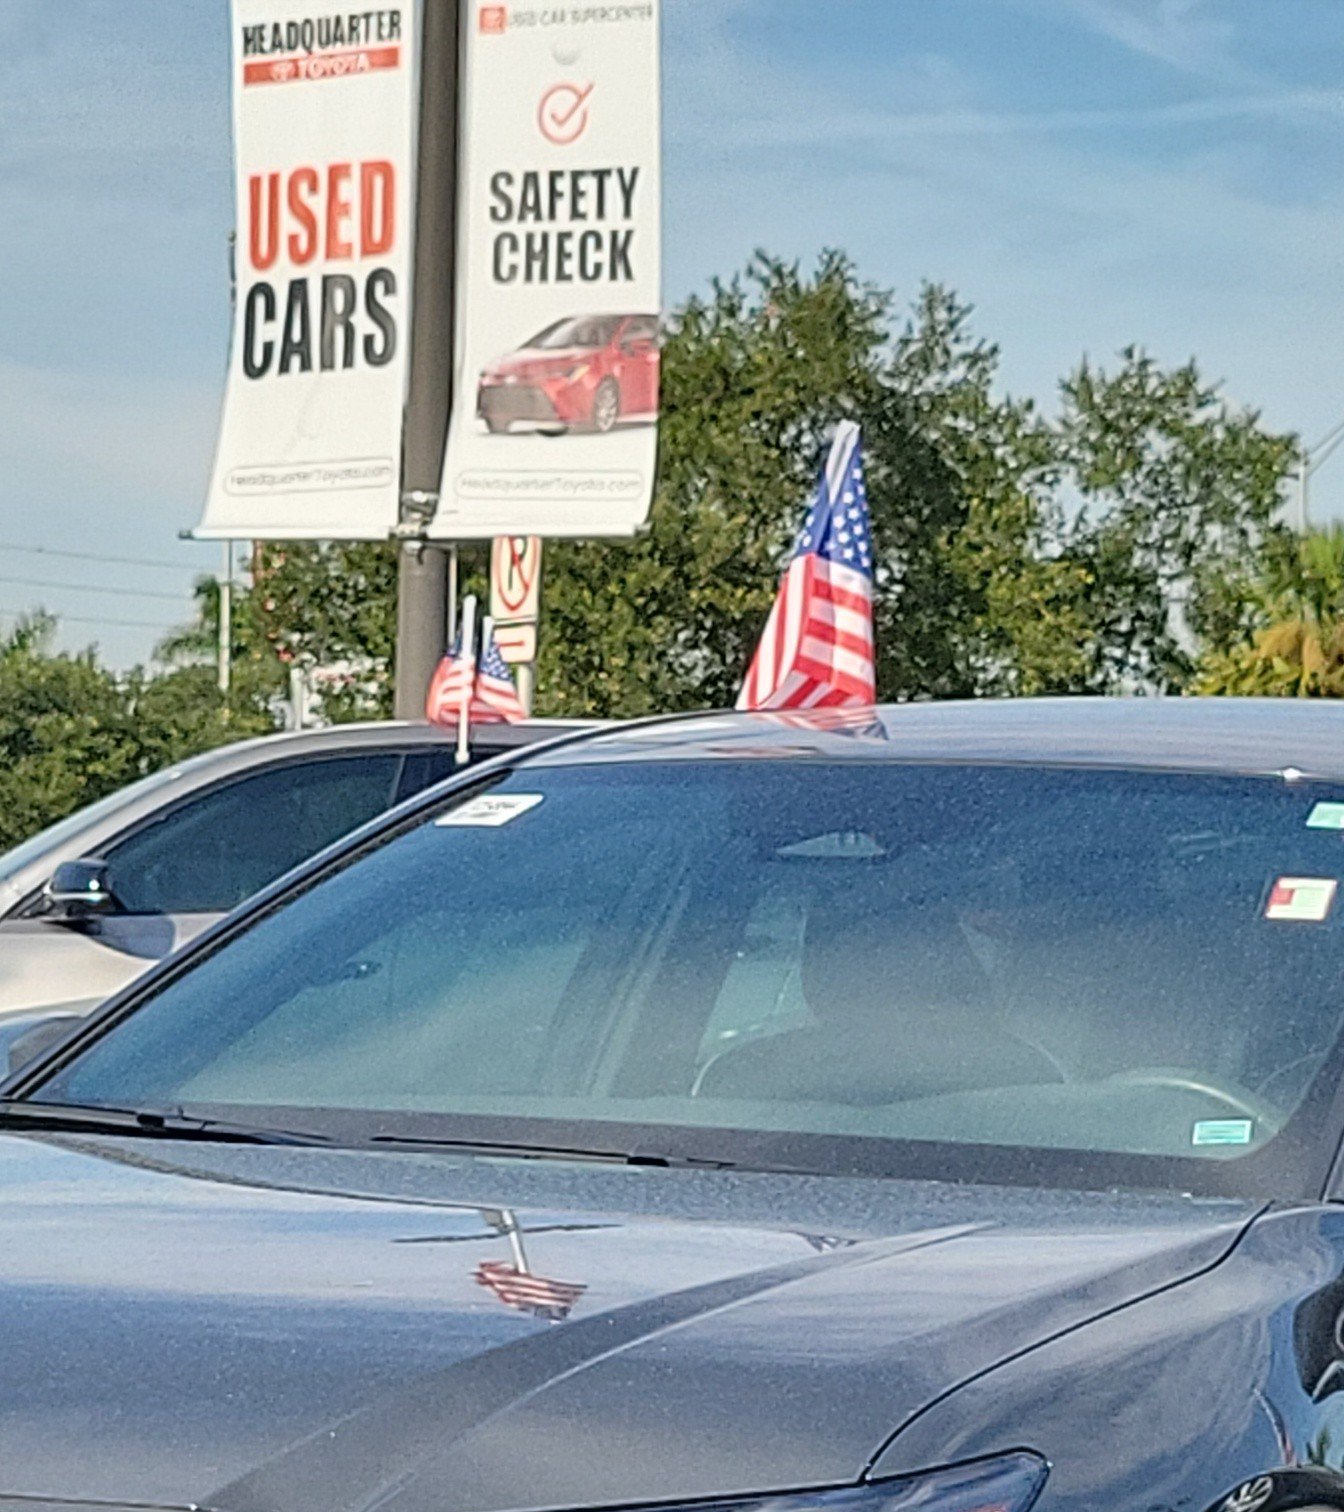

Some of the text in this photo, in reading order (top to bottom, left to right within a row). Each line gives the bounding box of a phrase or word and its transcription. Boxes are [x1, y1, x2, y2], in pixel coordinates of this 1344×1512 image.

[242, 10, 401, 55] HEADQUARTER
[297, 52, 370, 82] TOYOTA
[248, 160, 395, 271] USED
[489, 166, 639, 223] SAFETY
[492, 229, 635, 284] CHECK
[242, 267, 397, 379] CARS
